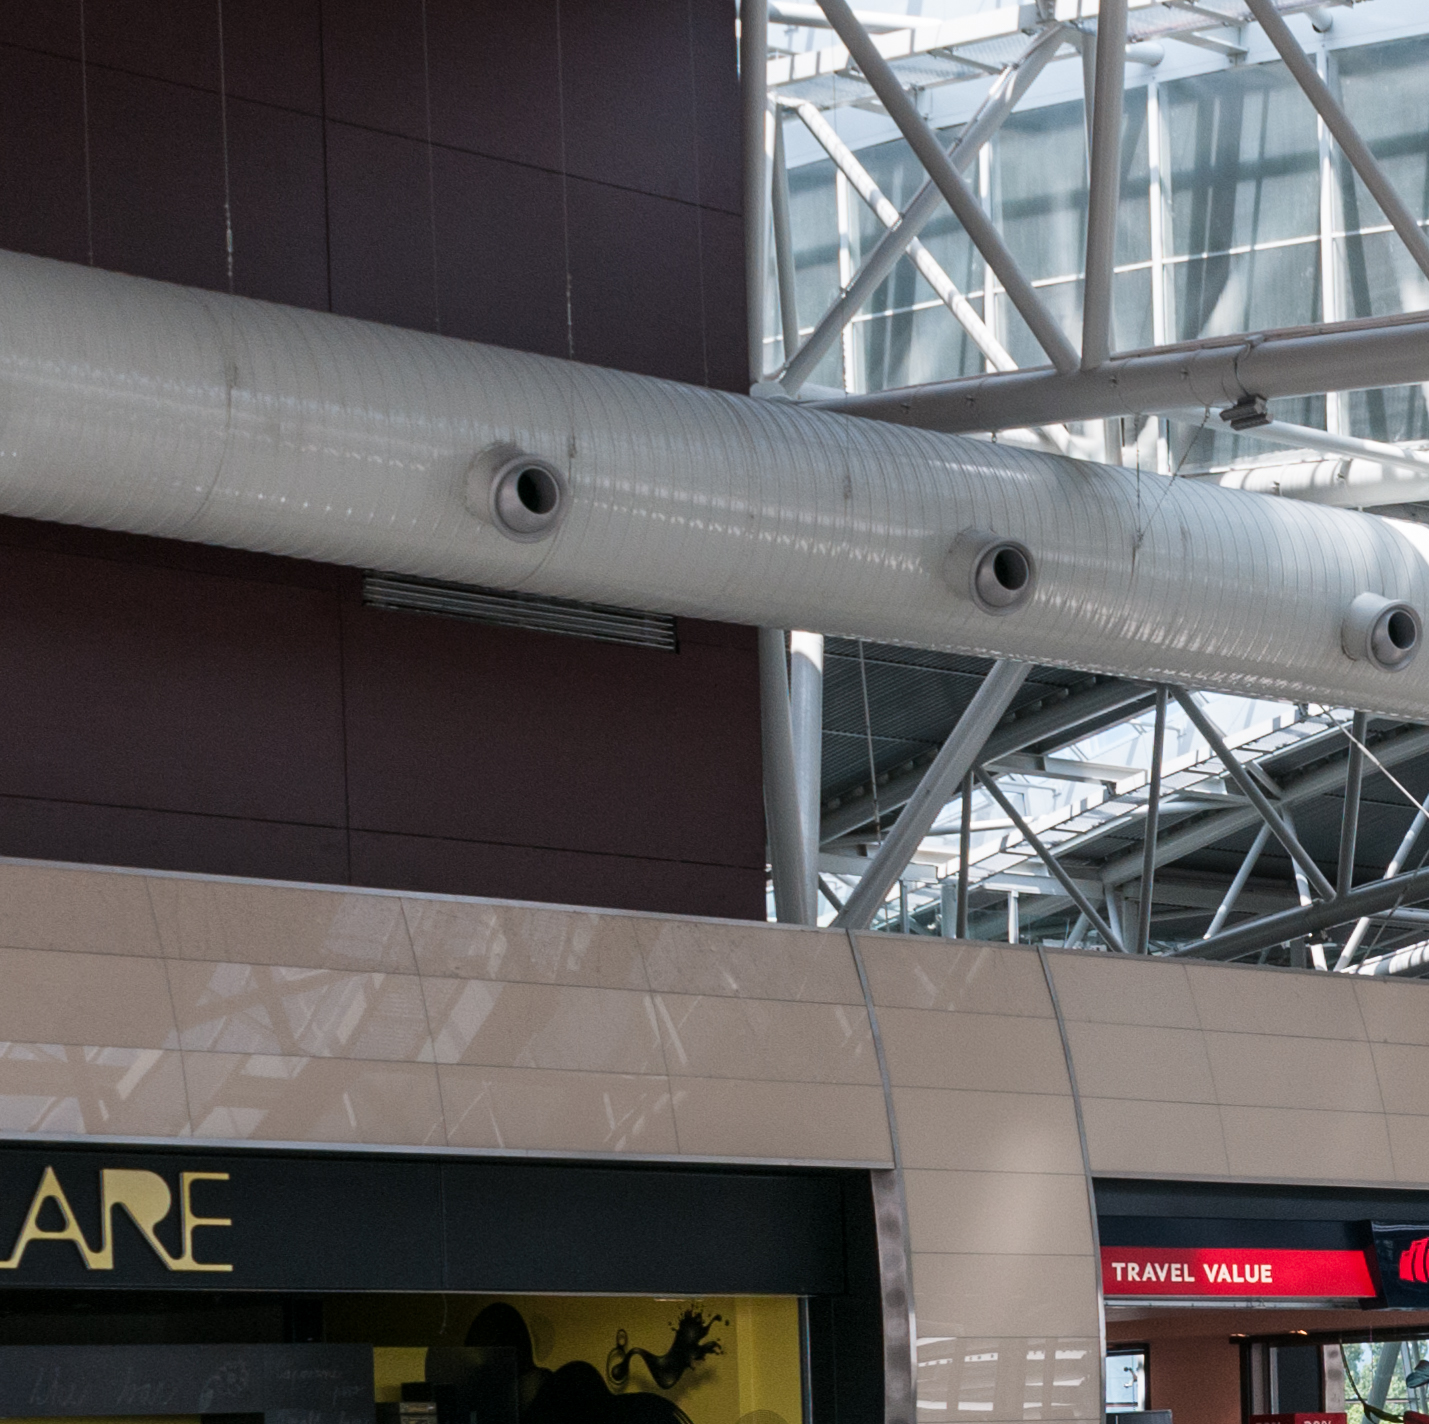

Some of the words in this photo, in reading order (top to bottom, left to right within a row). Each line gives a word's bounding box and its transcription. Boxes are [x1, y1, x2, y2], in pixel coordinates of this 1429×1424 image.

[0, 1166, 233, 1272] ARE
[1111, 1262, 1195, 1283] TRAVEL
[1203, 1263, 1273, 1283] VALUE
